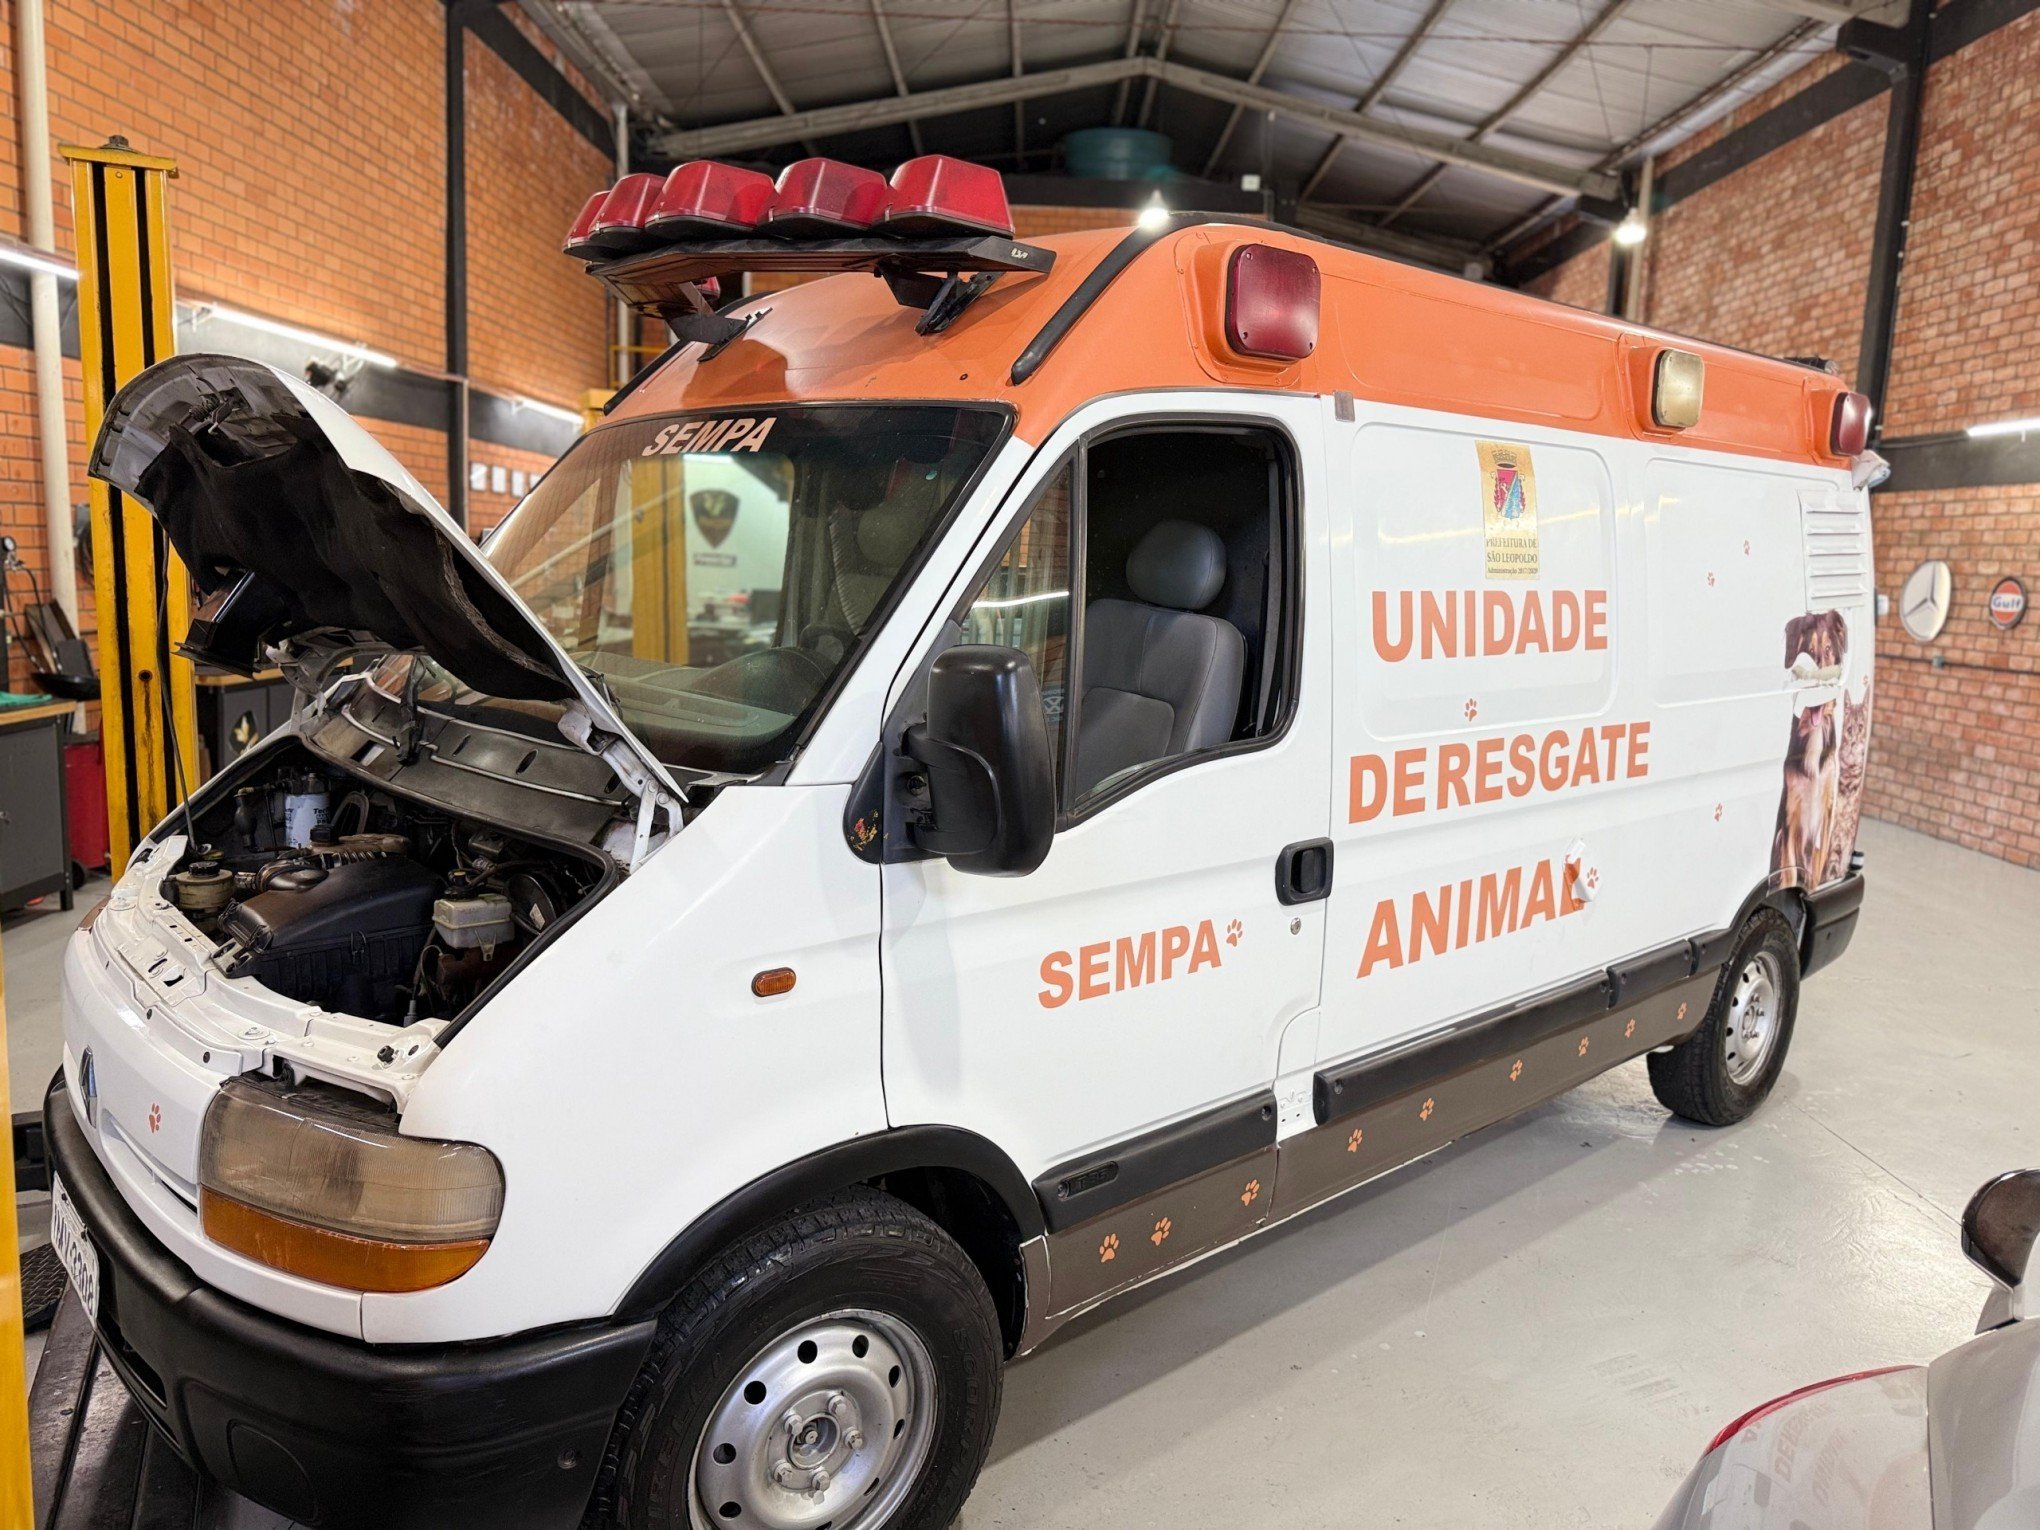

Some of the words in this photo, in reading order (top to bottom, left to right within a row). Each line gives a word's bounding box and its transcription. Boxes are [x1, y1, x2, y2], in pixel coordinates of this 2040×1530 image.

[642, 416, 777, 457] SEMPA
[1486, 537, 1527, 548] PREFEITURA
[1528, 538, 1537, 549] DE
[1487, 551, 1500, 563] SÃO
[1502, 553, 1538, 564] LEOPOLDO
[1993, 596, 2022, 609] Gulf
[1371, 589, 1608, 663] UNIDADE
[1348, 747, 1427, 825] DE
[1436, 721, 1651, 810] RESGATE
[1037, 919, 1222, 1009] SEMPA
